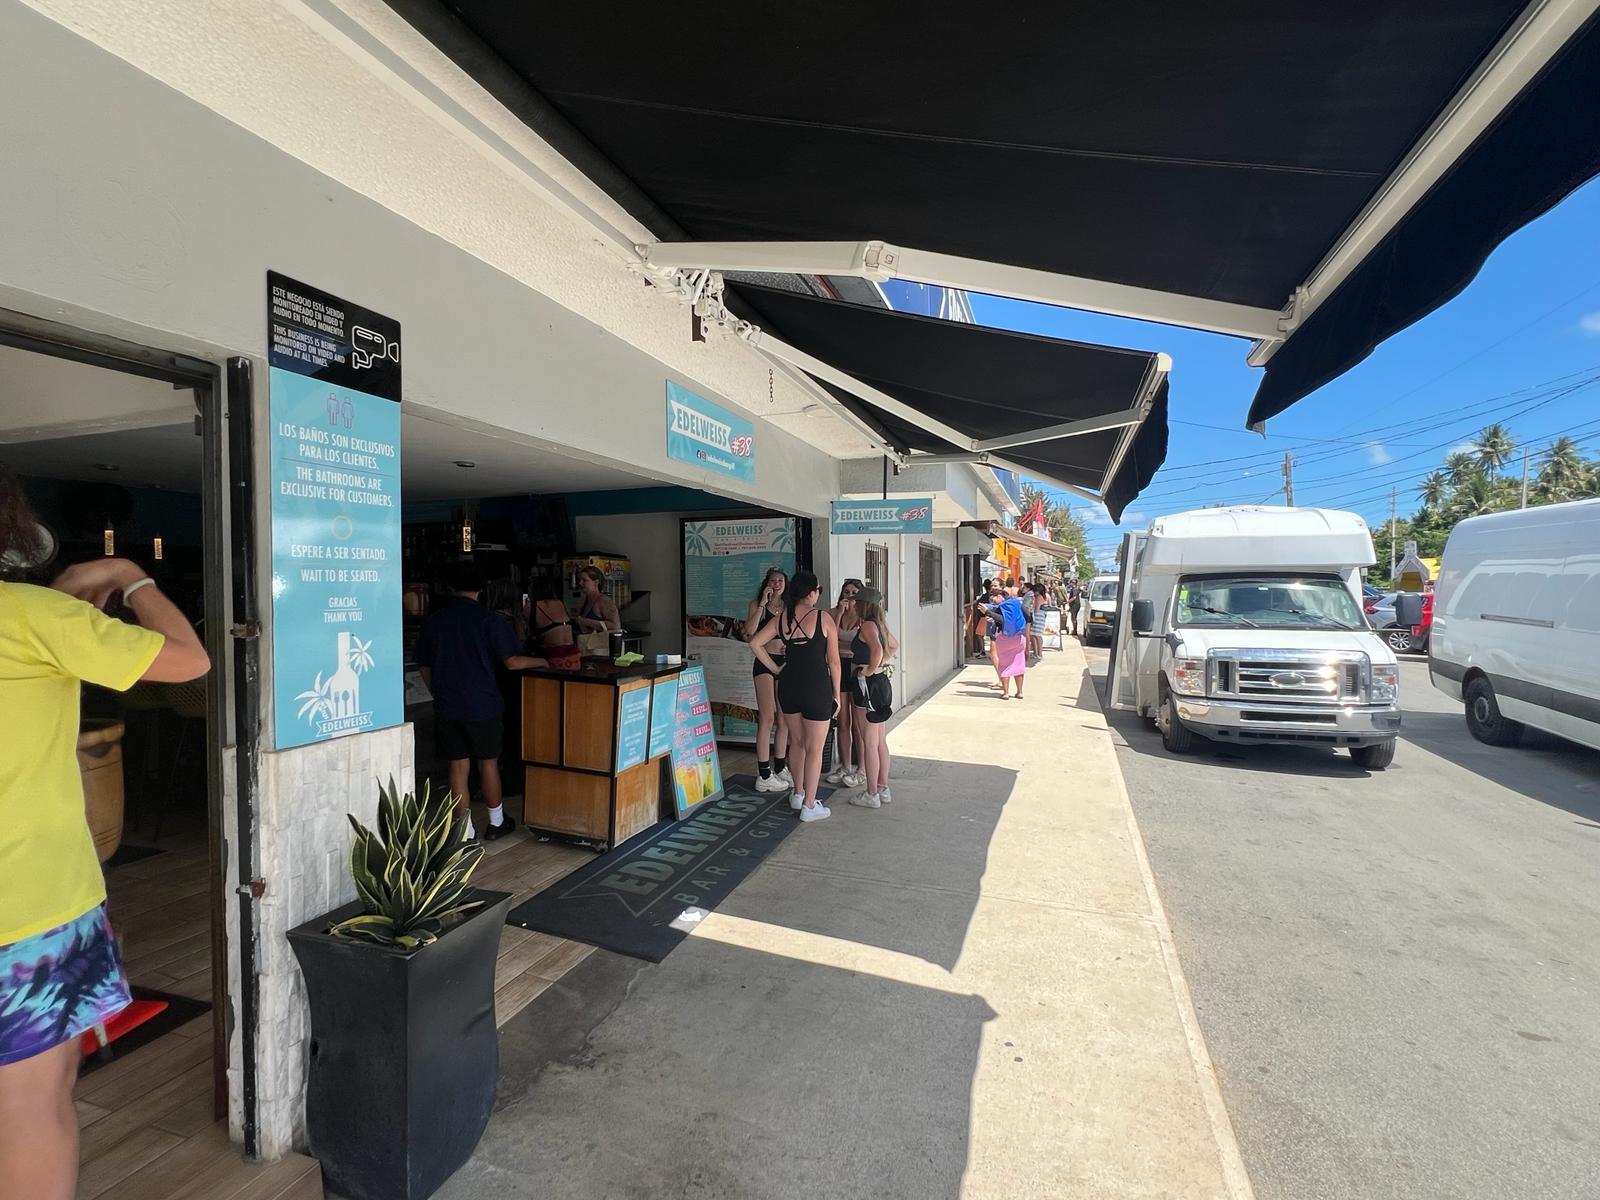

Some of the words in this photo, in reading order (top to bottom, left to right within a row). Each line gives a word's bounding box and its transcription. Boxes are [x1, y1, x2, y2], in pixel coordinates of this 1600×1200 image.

[273, 286, 286, 298] ESTE
[287, 291, 312, 307] NEGOCIO
[326, 305, 344, 320] SIENDO
[273, 296, 314, 317] MONITOREADO
[315, 310, 322, 320] EN
[339, 320, 343, 328] Y
[273, 306, 291, 319] AUDIO
[293, 312, 301, 321] EN
[302, 315, 316, 328] TODO
[318, 321, 345, 337] MOMENTO.
[273, 325, 286, 335] THIS
[288, 329, 313, 344] BUSINESS
[314, 337, 320, 346] IS
[321, 339, 337, 351] BEING
[274, 334, 306, 351] MONITORED
[308, 344, 316, 354] ON
[318, 347, 334, 360] VIDEO
[335, 353, 345, 363] AND
[274, 344, 292, 356] AUDIO
[294, 350, 301, 359] AT
[302, 353, 311, 363] ALL
[312, 357, 329, 367] TIMES.
[279, 422, 297, 438] LOS
[300, 427, 329, 444] BAÑOS
[332, 434, 349, 448] SON
[351, 438, 395, 457] EXCLUSIVOS
[677, 408, 727, 447] EDELWEISS
[731, 436, 752, 456] #38
[300, 444, 322, 459] PARA
[325, 448, 340, 462] LOS
[342, 452, 379, 469] CLIENTES.
[296, 466, 313, 480] THE
[316, 470, 366, 488] BATHROOMS
[368, 478, 382, 490] ARE
[281, 482, 326, 499] EXCLUSIVE
[329, 488, 346, 501] FOR
[348, 490, 395, 507] CUSTOMERS.
[841, 510, 893, 520] EDELWEISS
[900, 506, 928, 521] #38
[716, 525, 763, 536] EDELWEISS
[291, 544, 324, 558] ESPERE
[326, 547, 332, 559] A
[334, 547, 349, 559] SER
[351, 548, 388, 560] SENTADO.
[301, 569, 323, 582] WAIT
[325, 570, 336, 582] TO
[338, 570, 348, 582] BE
[351, 570, 380, 582] SEATED.
[328, 597, 357, 607] GRACIAS
[324, 612, 347, 623] THANK
[348, 611, 362, 621] YOU
[322, 715, 368, 732] EDELWEISS
[600, 792, 766, 896] EDELWEISS
[672, 864, 731, 904] BAR
[728, 847, 752, 856] &
[748, 810, 796, 838] GRIL
